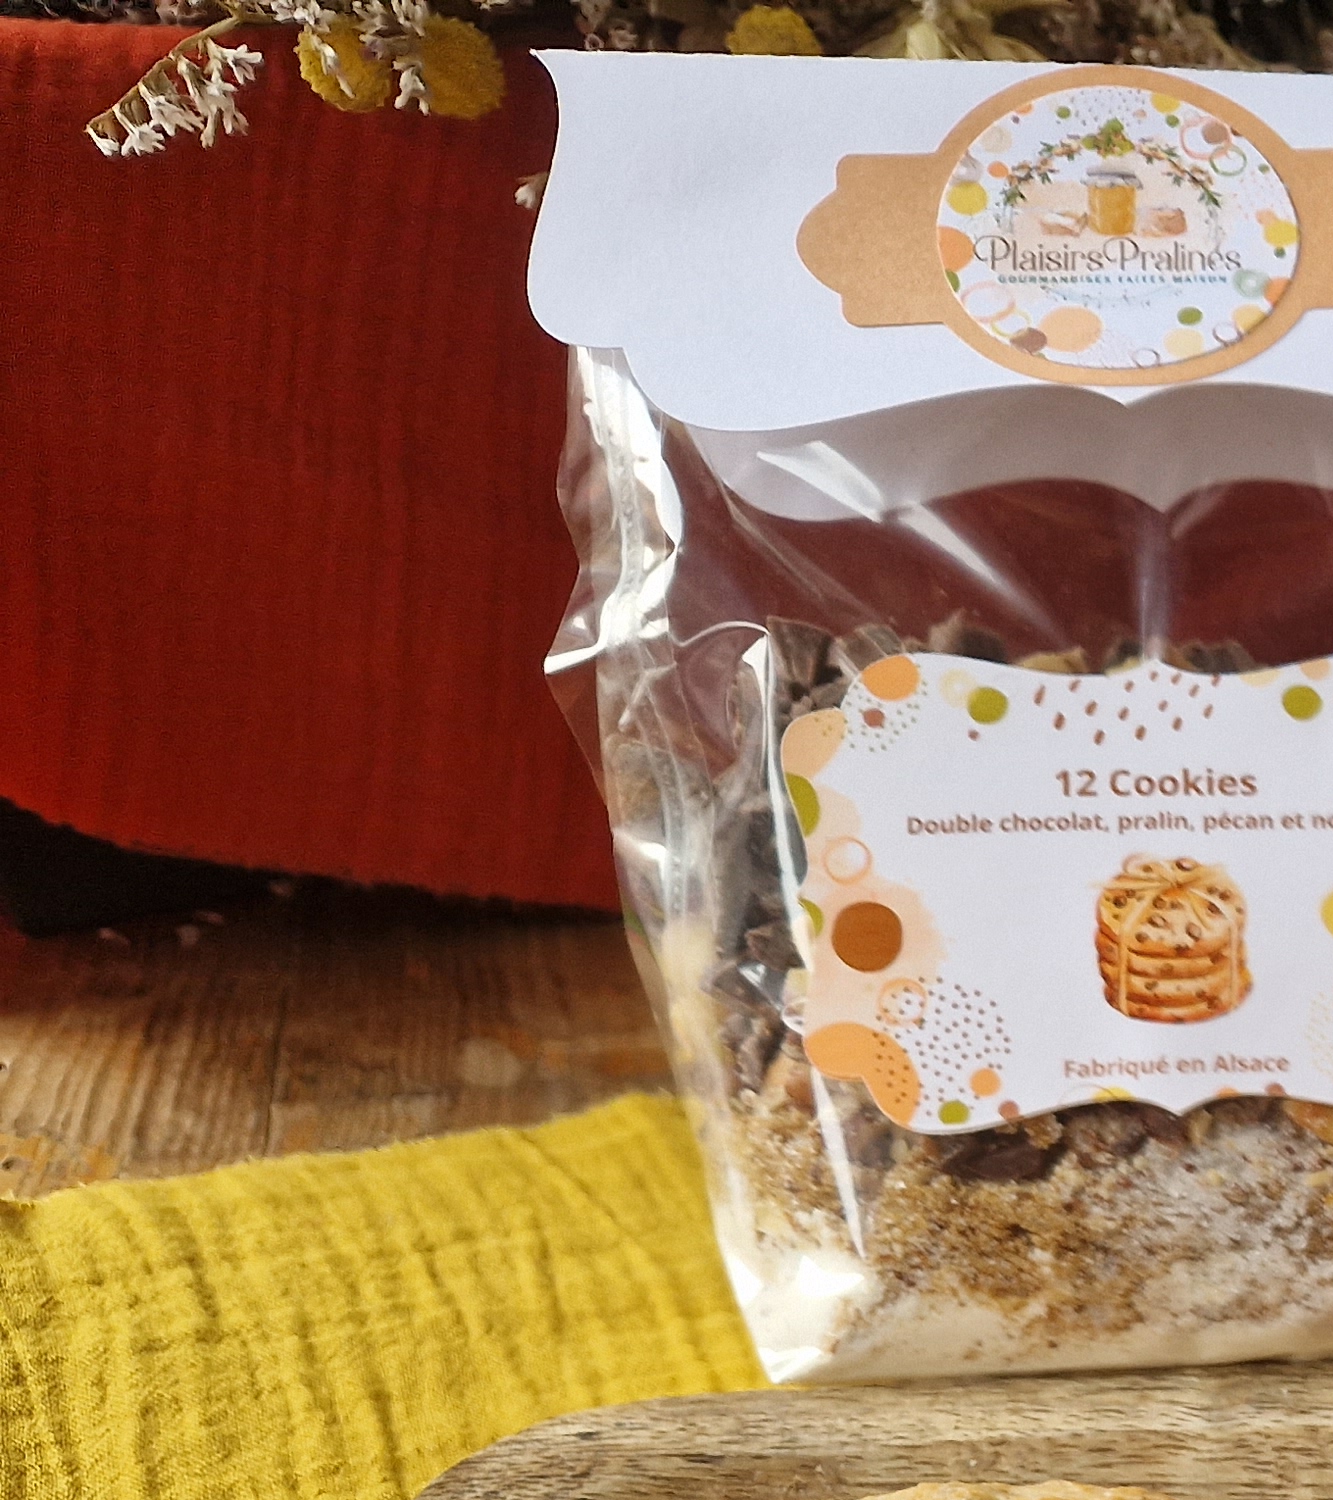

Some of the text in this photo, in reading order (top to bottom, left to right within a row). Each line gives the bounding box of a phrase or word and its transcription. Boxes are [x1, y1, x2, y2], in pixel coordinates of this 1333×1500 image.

[973, 235, 1103, 271] Plaisirs
[1056, 768, 1258, 798] 12 Cookies
[907, 814, 993, 835] Double
[1000, 812, 1109, 833] chocolat,
[1118, 811, 1195, 834] pralin,
[1203, 811, 1274, 834] pécan
[1281, 814, 1305, 830] et
[1064, 1053, 1290, 1080] Fabriqué en Alsace
